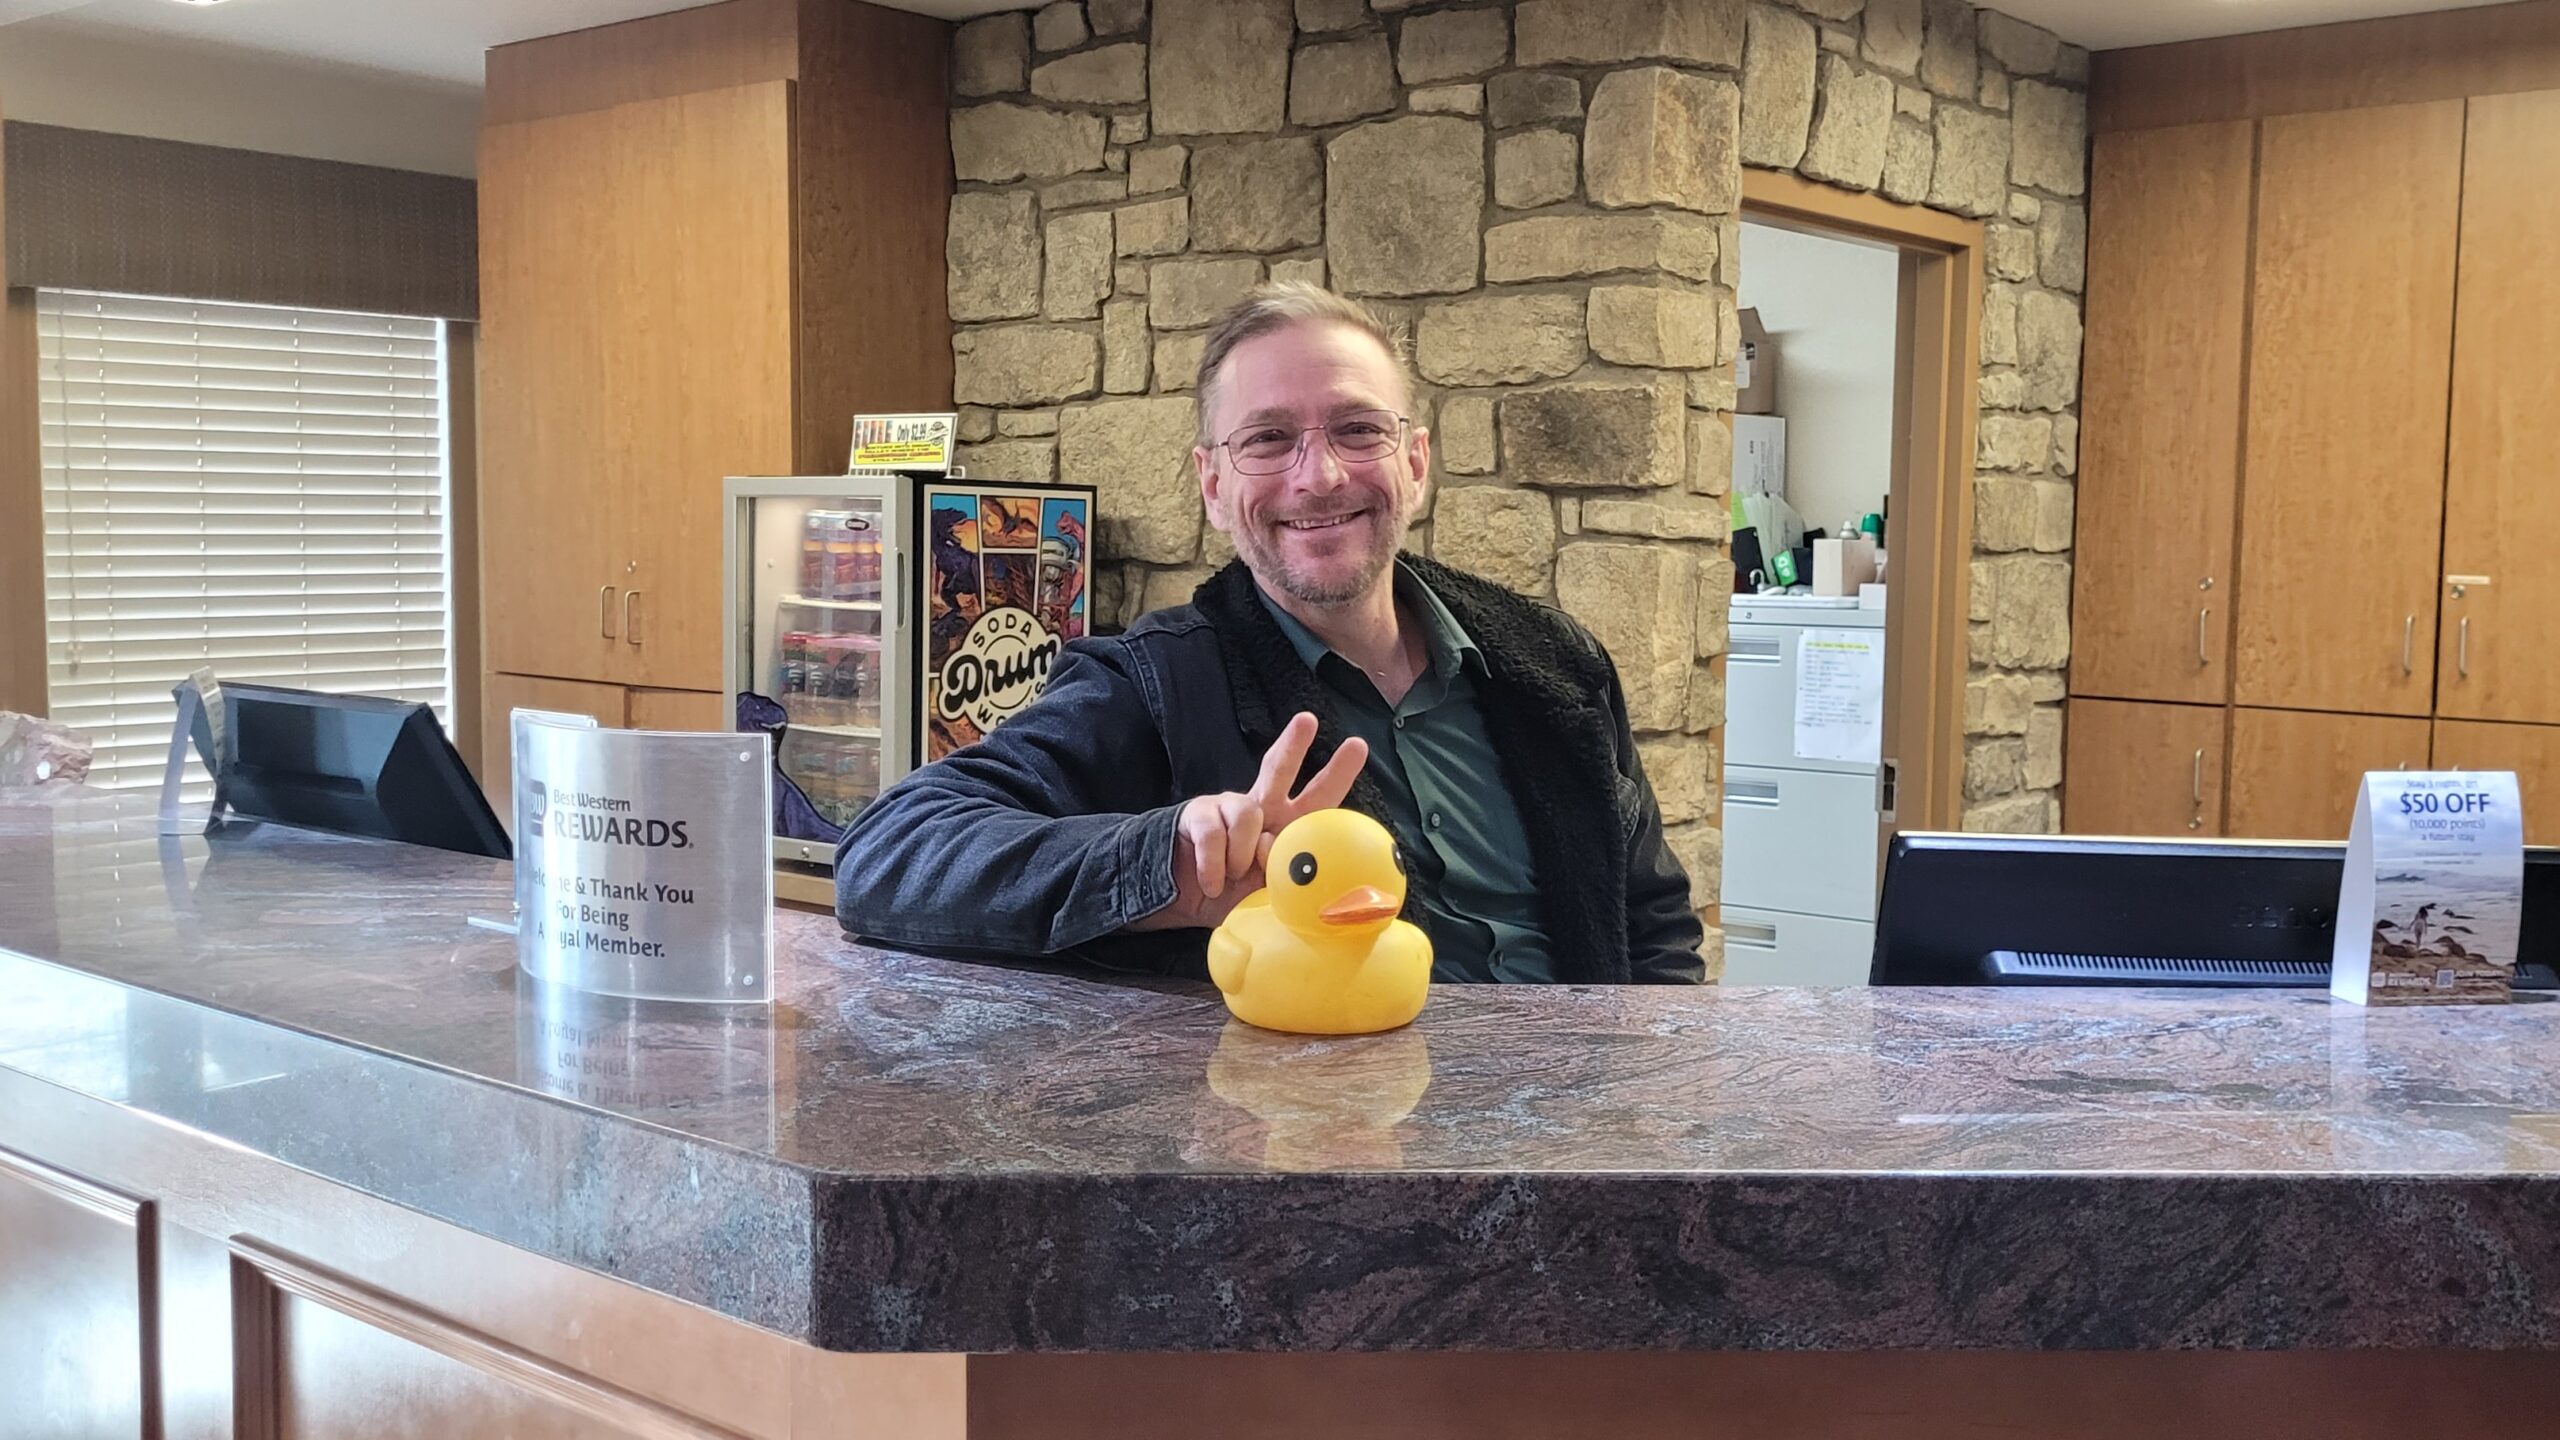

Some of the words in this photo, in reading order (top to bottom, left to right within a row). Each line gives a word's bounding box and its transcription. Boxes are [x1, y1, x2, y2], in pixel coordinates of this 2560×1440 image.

[972, 613, 1033, 648] SODA
[944, 639, 1057, 714] Drum
[554, 789, 576, 806] Best
[576, 793, 632, 812] Western
[2400, 792, 2439, 815] $50
[2445, 792, 2491, 814] OFF
[2409, 818, 2448, 831] (10,000
[2450, 818, 2486, 832] points)
[2429, 832, 2455, 841] future
[2457, 832, 2475, 843] stay
[575, 877, 587, 895] &
[590, 878, 649, 902] Thank
[654, 884, 695, 904] You
[537, 921, 545, 940] A
[581, 904, 630, 932] Being
[585, 931, 666, 958] Member.
